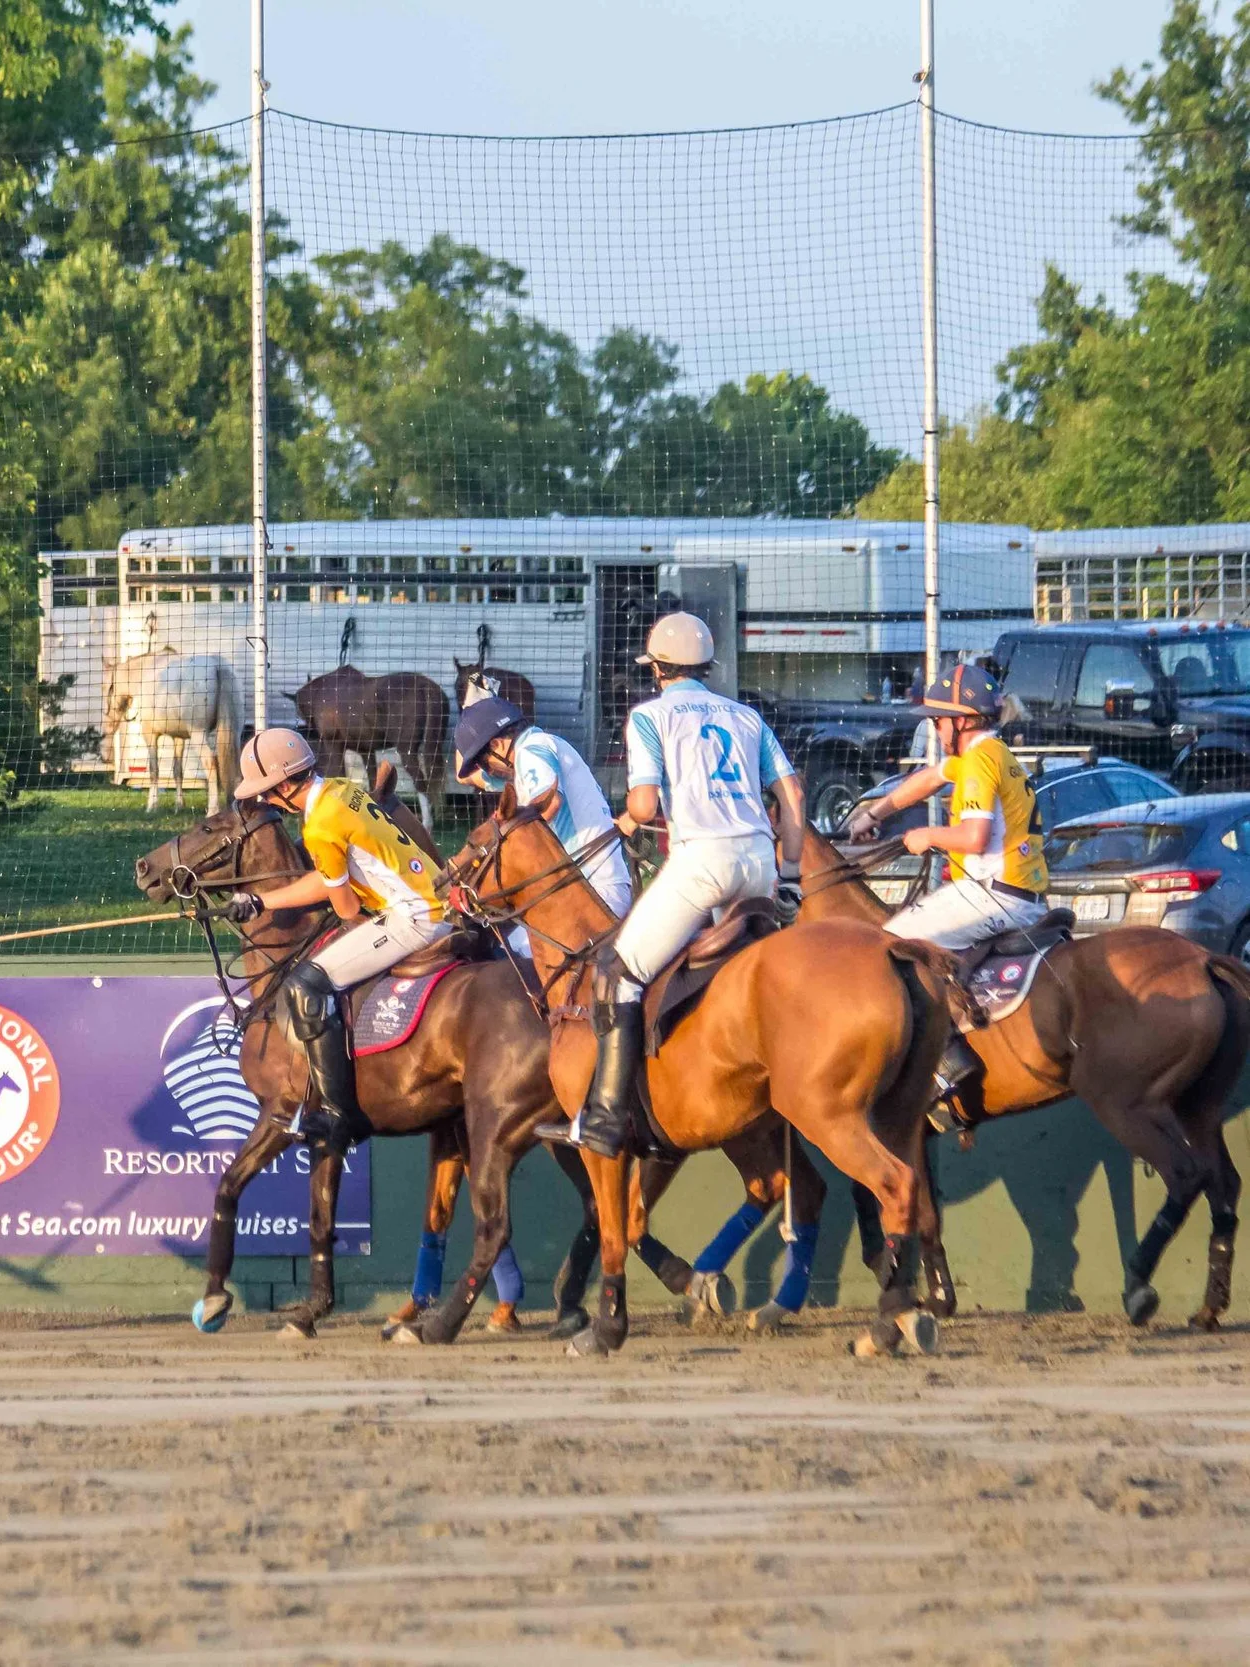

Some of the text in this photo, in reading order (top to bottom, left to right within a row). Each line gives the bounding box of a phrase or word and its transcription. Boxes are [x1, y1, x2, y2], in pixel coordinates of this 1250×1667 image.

[700, 723, 742, 782] 2
[366, 803, 411, 846] 3
[15, 1211, 122, 1236] Sea.com
[127, 1210, 208, 1242] luxury
[234, 1211, 299, 1236] uises
